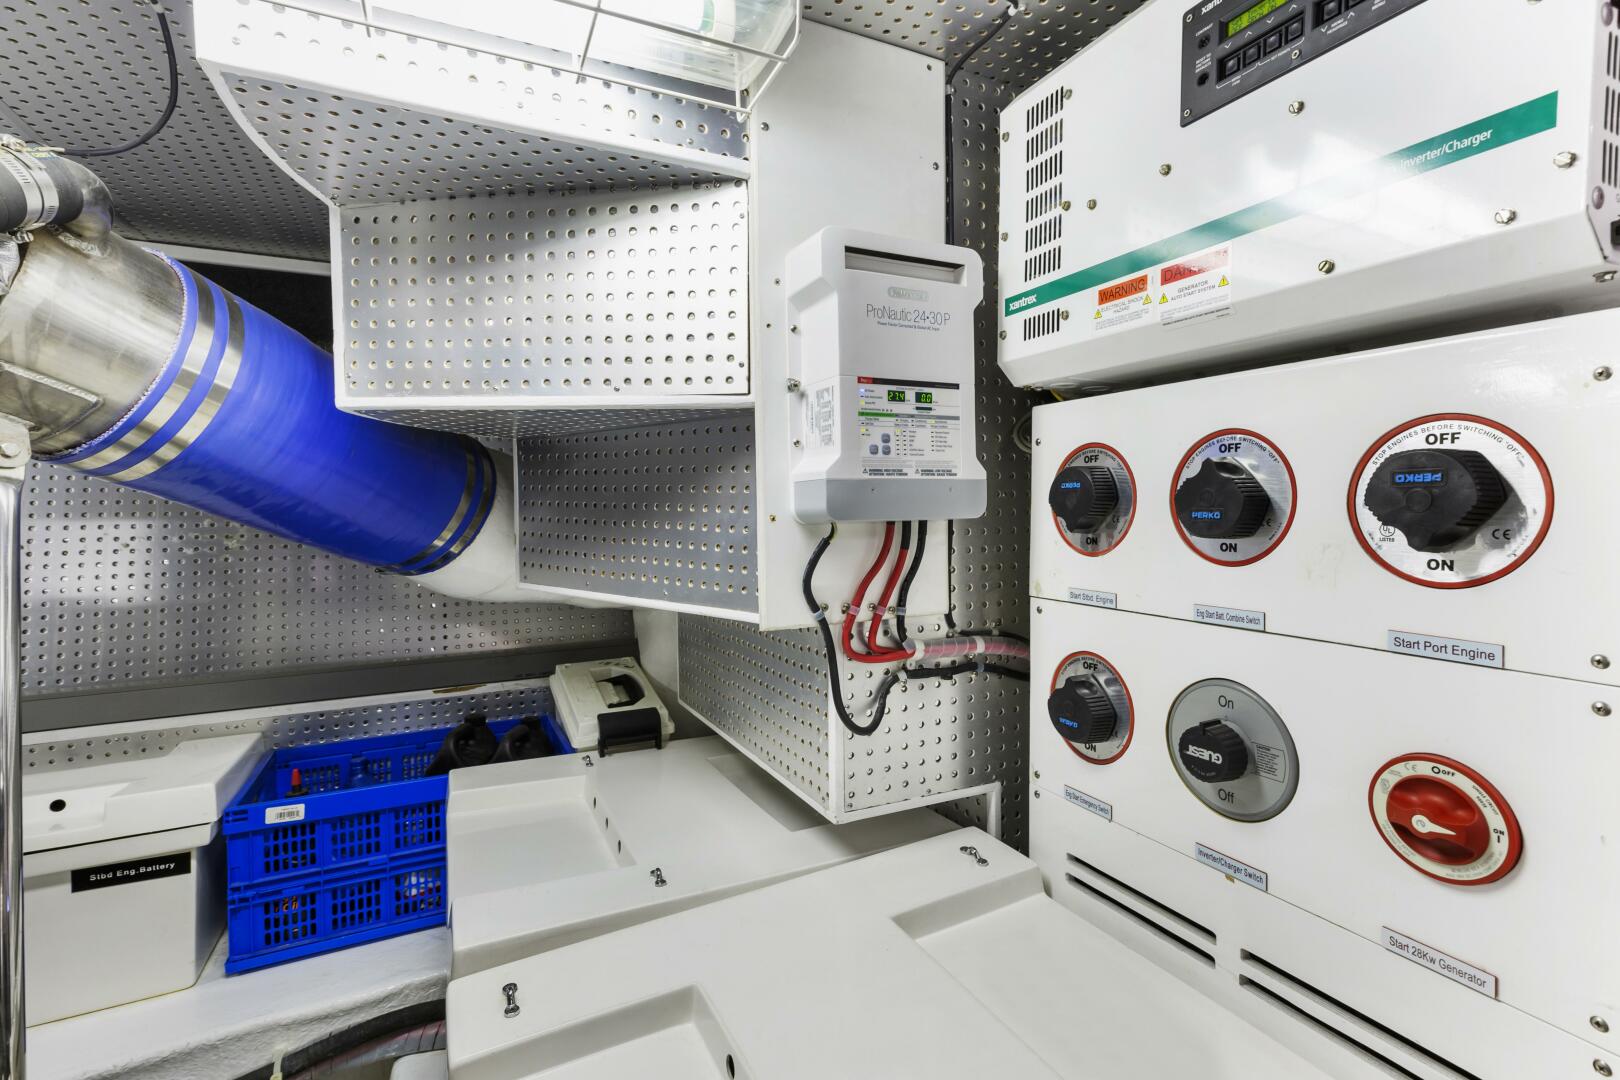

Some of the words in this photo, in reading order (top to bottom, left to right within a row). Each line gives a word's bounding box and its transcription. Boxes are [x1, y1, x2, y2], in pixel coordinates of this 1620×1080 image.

[1400, 129, 1493, 169] Inverter/Charger
[1100, 279, 1146, 302] WARNING
[1177, 280, 1208, 293] GENERATOR
[1009, 294, 1037, 311] xantrex
[866, 304, 912, 321] ProNautic
[1372, 449, 1387, 466] STOP
[1387, 429, 1419, 450] ENGINES
[1421, 423, 1454, 434] BEFORE
[1457, 424, 1503, 443] SWITCHING
[1425, 432, 1461, 445] OFF
[1185, 456, 1195, 469] STOP
[1195, 441, 1215, 457] ENGINES
[1216, 436, 1237, 444] BEFORE
[1238, 436, 1267, 452] SWITCHING
[1218, 443, 1241, 453] OFF
[1083, 455, 1099, 463] OFF
[1395, 473, 1442, 483] PERKO
[1191, 511, 1220, 519] PERKO
[1085, 537, 1098, 545] ON
[1219, 543, 1238, 553] ON
[1426, 559, 1454, 571] ON
[1070, 591, 1081, 600] Start
[1095, 595, 1114, 605] Engine
[1205, 609, 1216, 619] Start
[1226, 613, 1245, 623] Combine
[1245, 615, 1261, 625] Switch
[1393, 637, 1420, 650] Start
[1423, 641, 1448, 654] Port
[1451, 645, 1496, 661] Engine
[1082, 661, 1099, 671] OFF
[1218, 695, 1234, 709] On
[1084, 743, 1097, 752] ON
[1184, 744, 1223, 765] GUEST
[1441, 769, 1455, 777] OFF
[1217, 788, 1235, 804] Off
[1493, 828, 1505, 836] ON
[1198, 848, 1243, 874] Inverter/Charger
[1243, 868, 1264, 884] Switch
[89, 872, 113, 880] Stbd
[1389, 936, 1410, 953] Start
[1411, 946, 1437, 965] 28Kw
[1438, 958, 1487, 988] Generator
